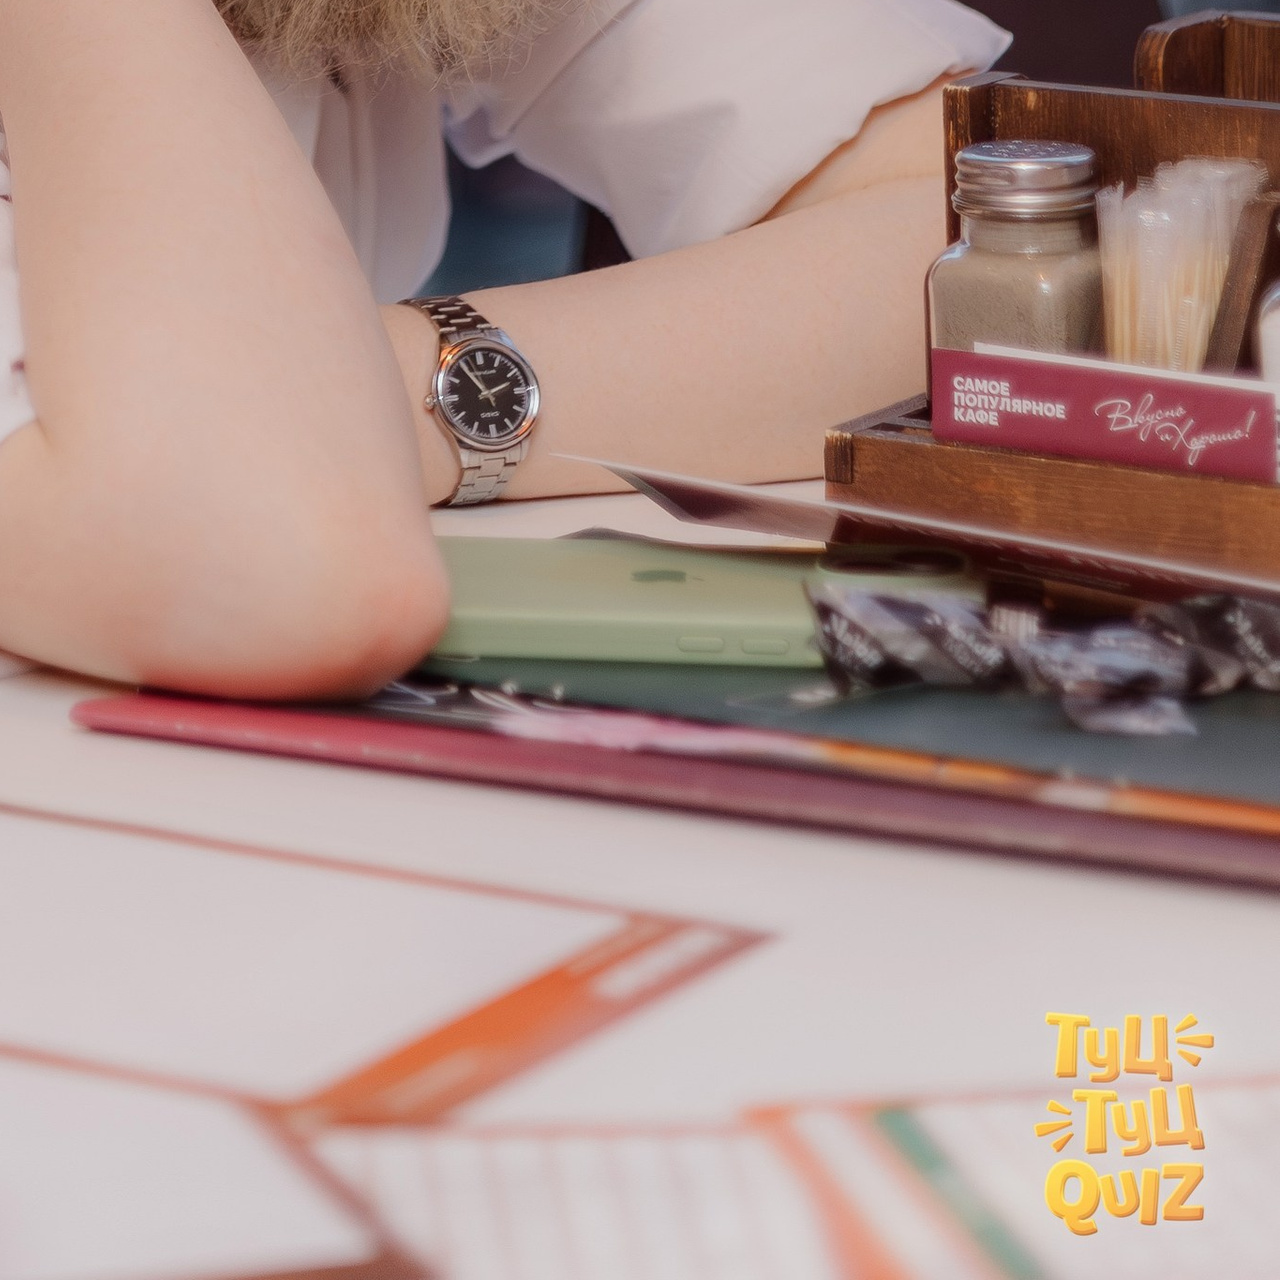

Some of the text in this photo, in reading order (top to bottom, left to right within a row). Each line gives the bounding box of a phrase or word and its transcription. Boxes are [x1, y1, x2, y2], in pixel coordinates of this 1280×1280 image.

[953, 376, 1010, 396] САМОЕ
[954, 392, 1066, 419] ПОПУЛЯРНОЕ
[954, 407, 999, 426] КАФЕ
[1095, 393, 1186, 441] Вкусно
